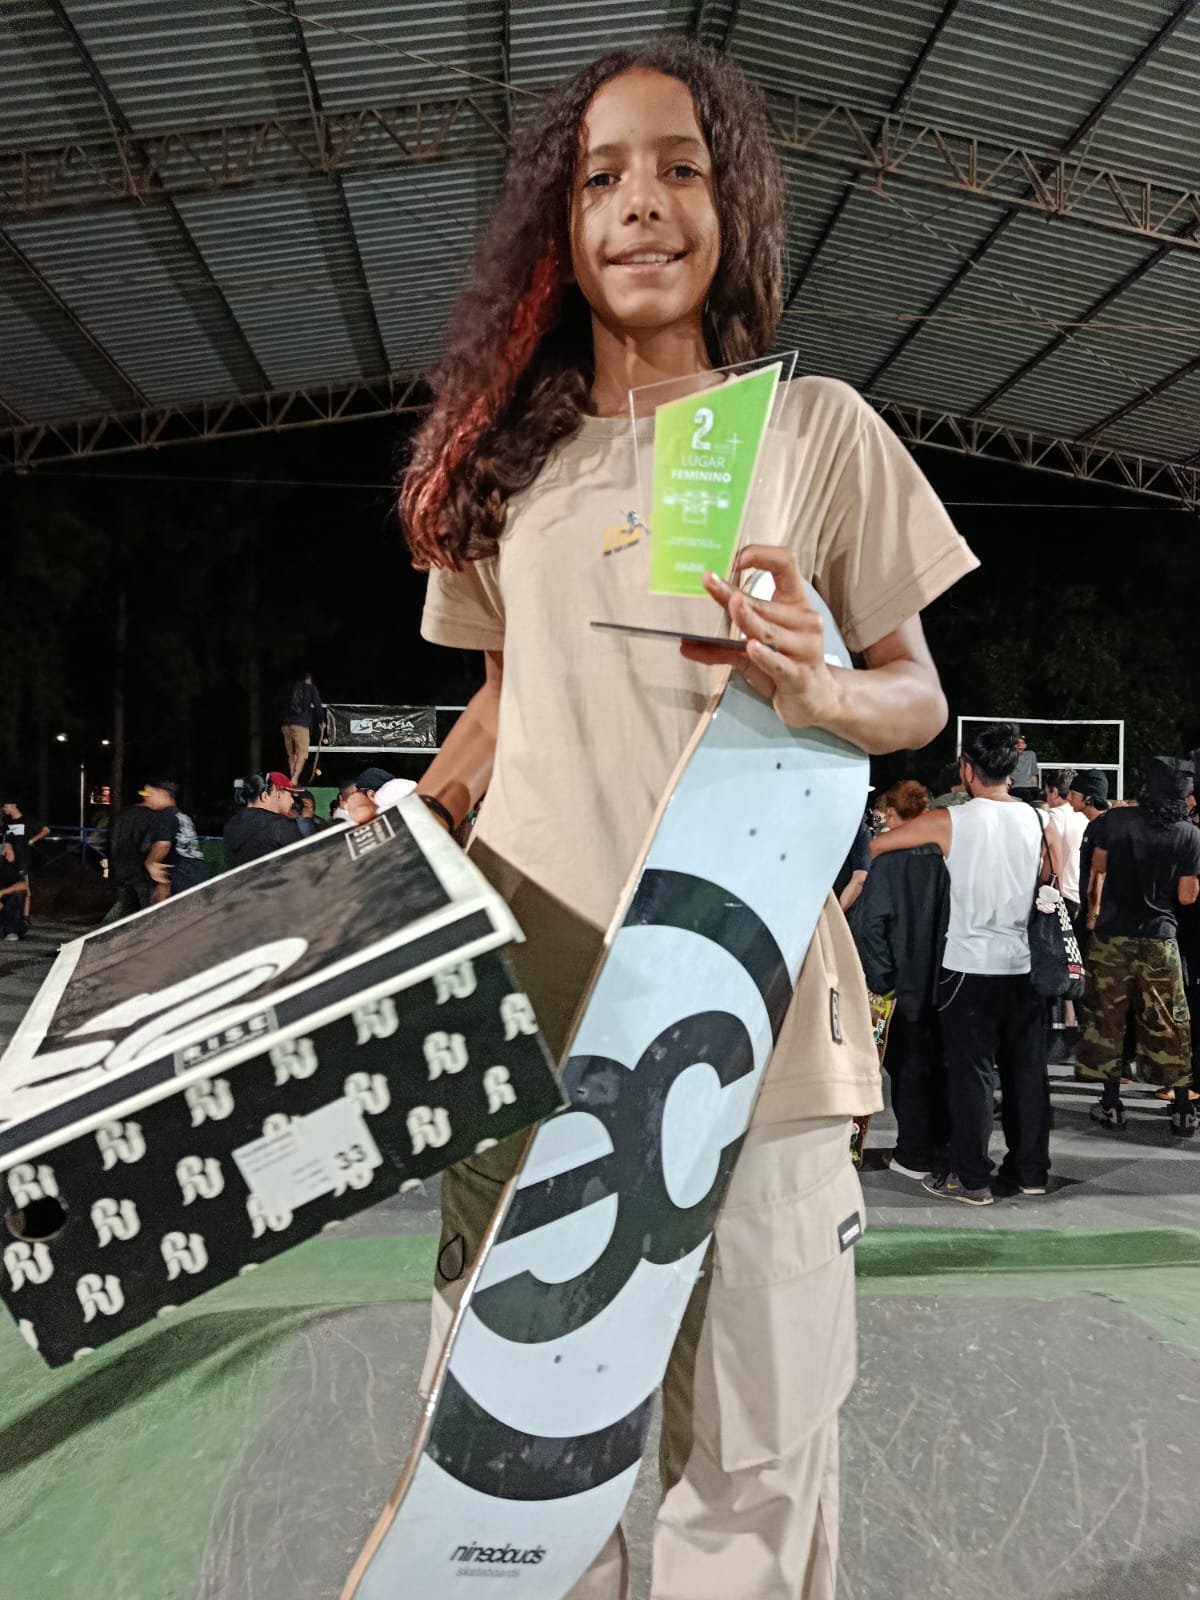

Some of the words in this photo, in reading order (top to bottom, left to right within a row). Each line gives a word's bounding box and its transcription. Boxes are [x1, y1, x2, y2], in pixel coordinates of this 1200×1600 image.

[692, 408, 714, 450] 2
[682, 454, 726, 468] LUGAR
[672, 471, 731, 483] FEMININO
[336, 1144, 366, 1170] 33
